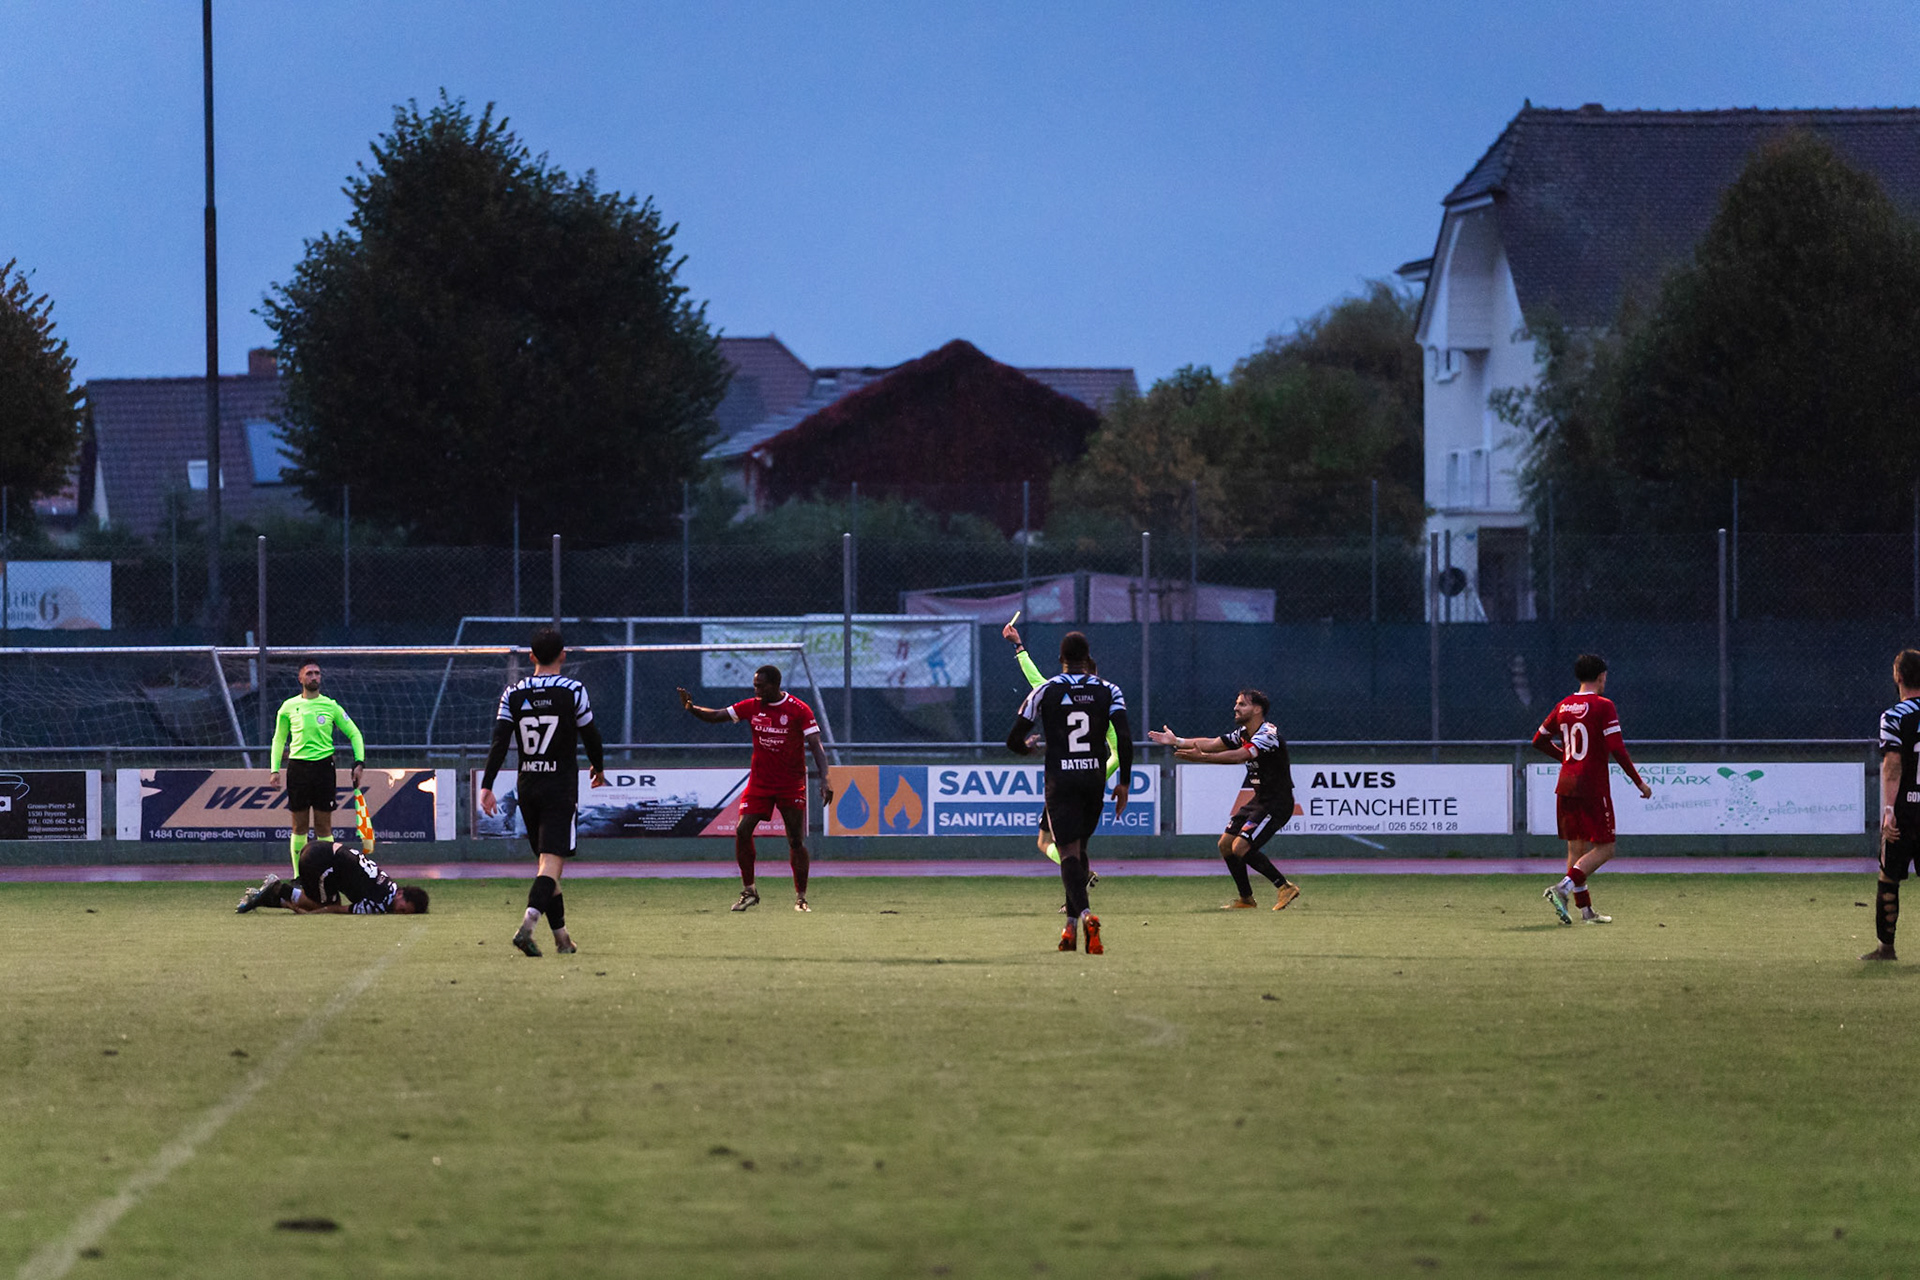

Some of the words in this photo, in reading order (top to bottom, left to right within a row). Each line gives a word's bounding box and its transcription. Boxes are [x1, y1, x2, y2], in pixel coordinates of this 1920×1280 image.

[519, 715, 559, 755] 67
[1067, 711, 1090, 753] 2
[1560, 722, 1589, 761] 10
[521, 760, 557, 772] AMETAJ
[1060, 758, 1100, 771] BATISTA
[1311, 772, 1396, 789] ALVES
[1670, 775, 1711, 785] ARX
[1309, 796, 1458, 816] ÉTANCHÉITÉ
[1644, 798, 1719, 812] BANNERET
[1769, 803, 1858, 815] PROMENADE
[1294, 822, 1300, 831] 6
[1310, 823, 1328, 832] 1720
[1329, 822, 1380, 831] Corminboeuf
[1388, 822, 1406, 831] 026
[1409, 822, 1427, 831] 552
[1432, 822, 1443, 831] 18
[1445, 822, 1458, 831] 28
[149, 829, 173, 839] 1484
[175, 829, 265, 841] Granges-de-Vesin
[333, 829, 345, 839] 92
